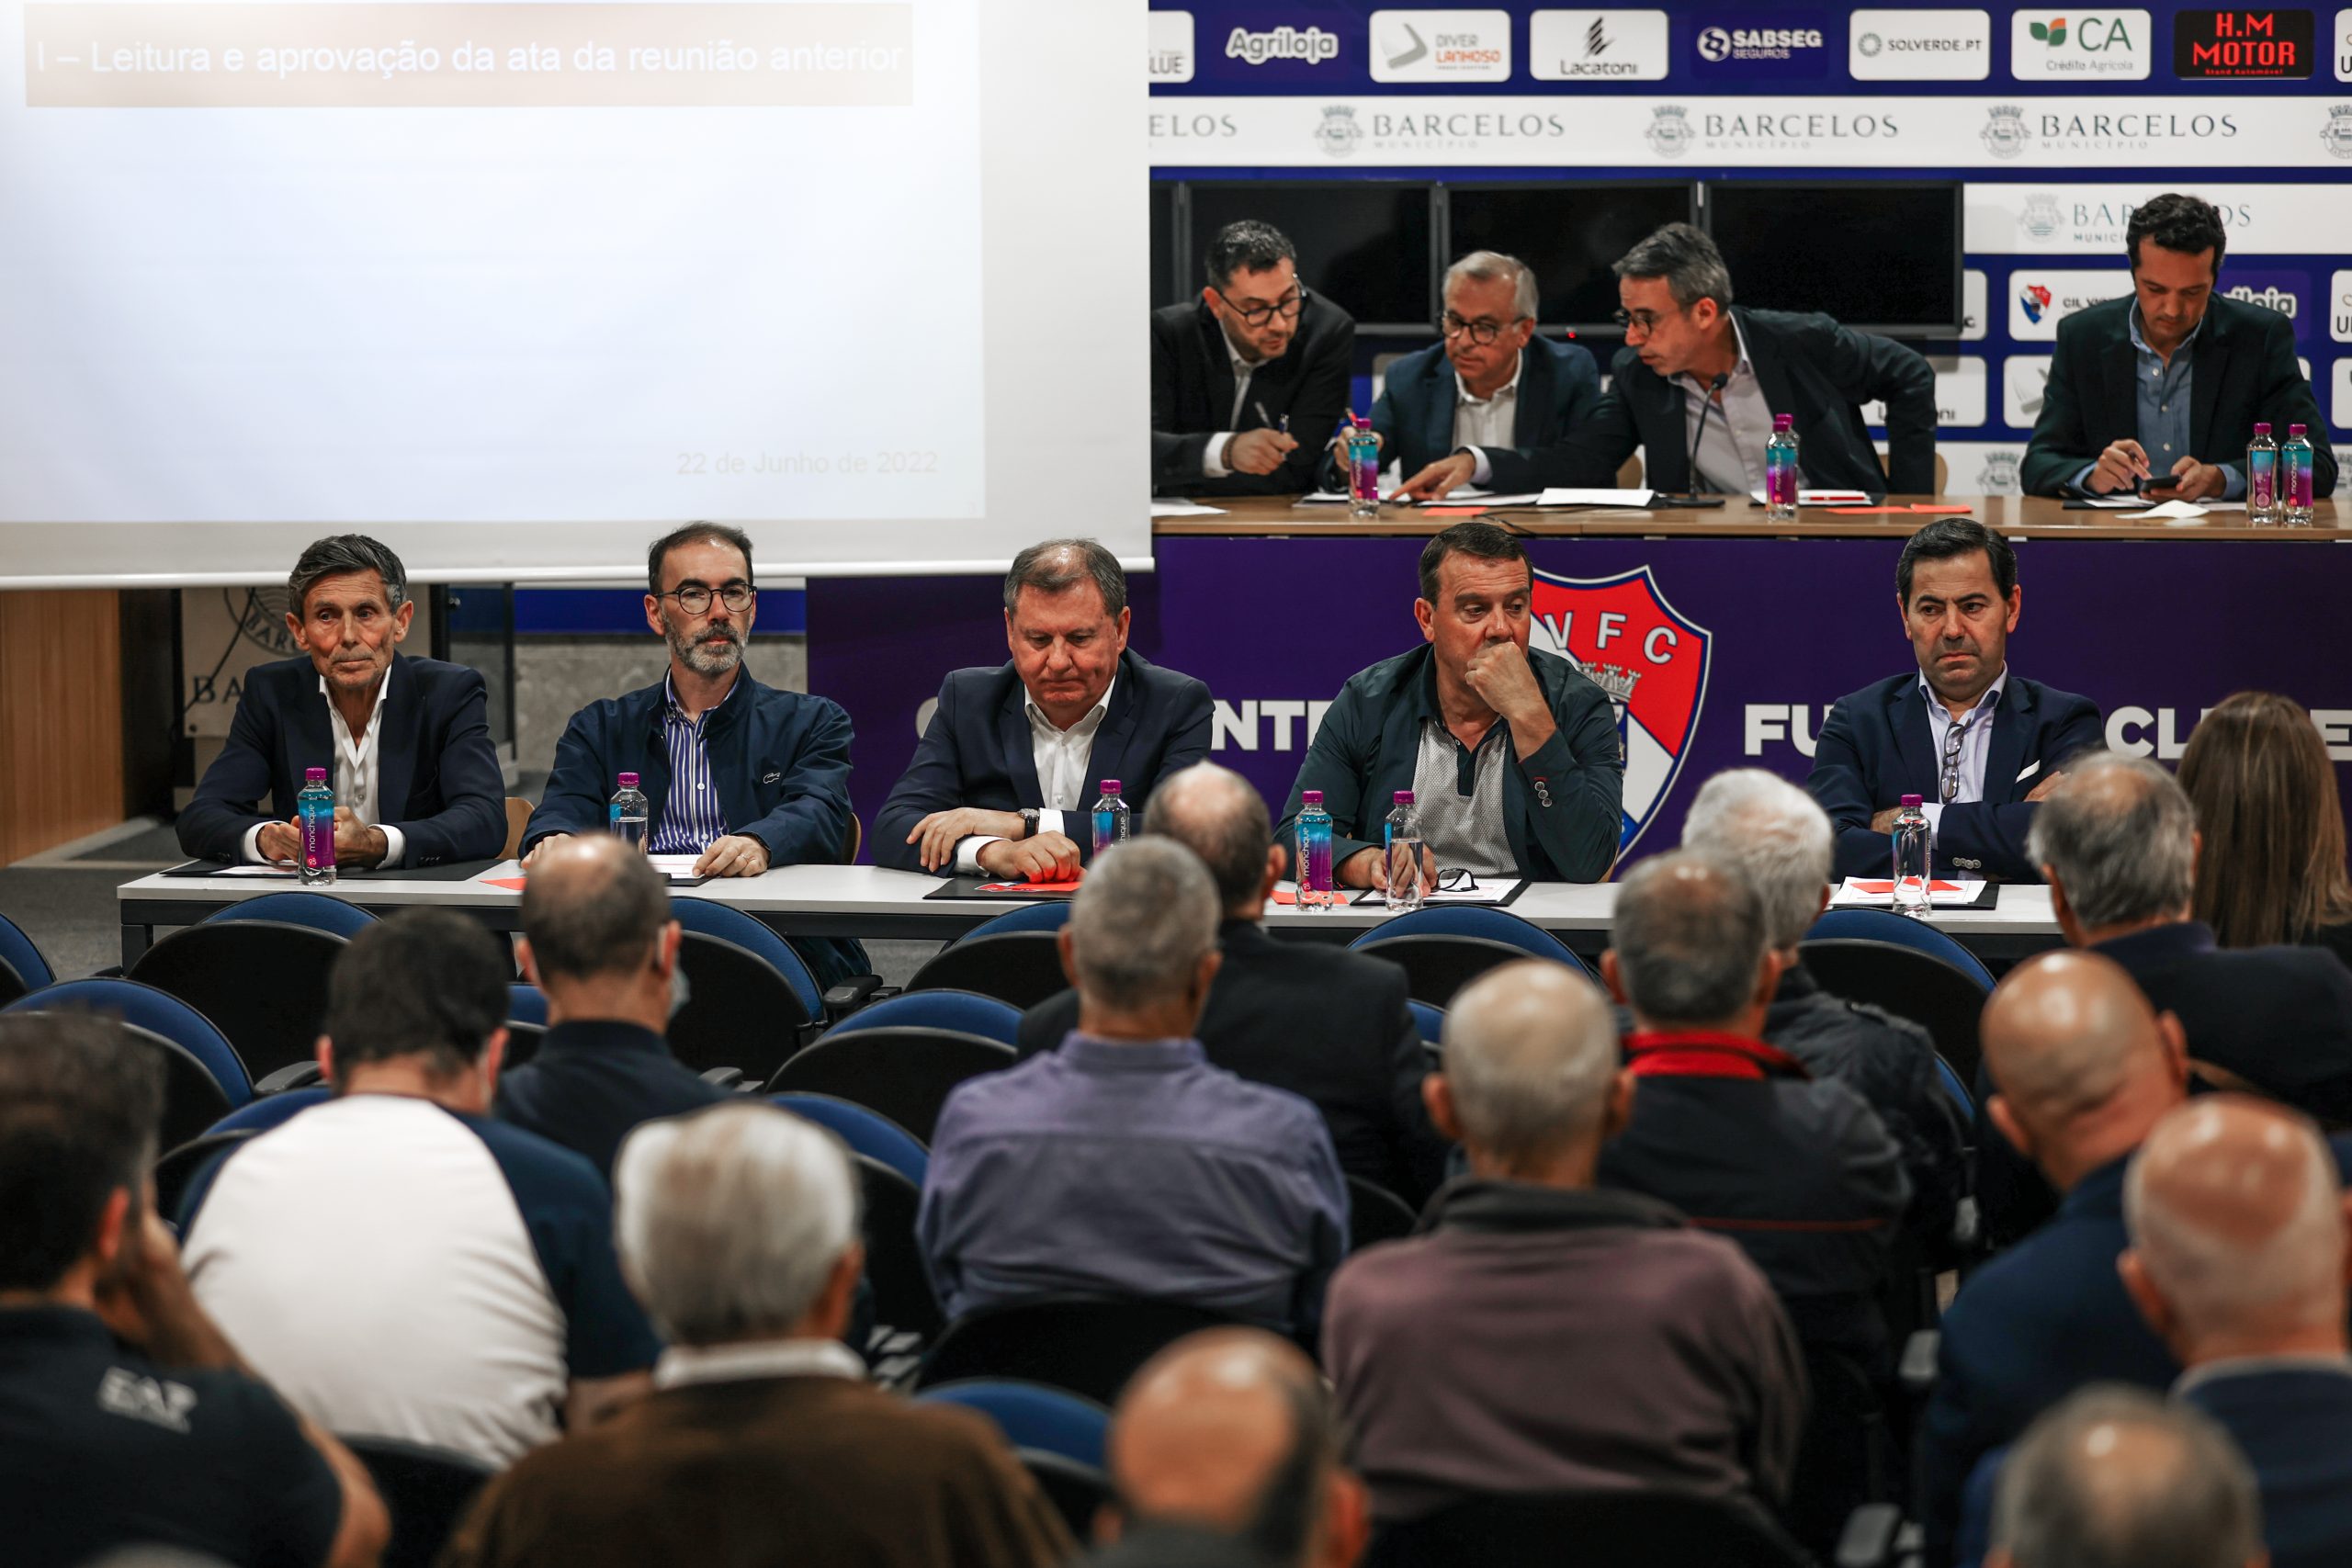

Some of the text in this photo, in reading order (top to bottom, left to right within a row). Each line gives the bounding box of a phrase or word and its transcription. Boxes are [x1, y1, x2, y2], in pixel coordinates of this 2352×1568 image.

[2078, 17, 2133, 51] CA
[2216, 12, 2274, 37] H.M
[1227, 28, 1338, 63] Agriloja
[1436, 34, 1478, 47] DIVER
[1733, 30, 1823, 48] SABSEG
[1888, 39, 1982, 51] SOLVERDE.PT
[92, 41, 211, 72] Leitura
[223, 48, 244, 72] e
[256, 40, 440, 79] aprovação
[452, 41, 495, 72] da
[507, 42, 561, 72] ata
[573, 41, 616, 72] da
[628, 40, 758, 72] reunião
[770, 41, 905, 72] anterior
[1733, 49, 1791, 59] SEGUROS
[2193, 41, 2295, 66] MOTOR
[1148, 56, 1184, 74] LUE
[1561, 60, 1639, 75] Lacatoni
[2046, 60, 2086, 71] Crédito
[1148, 115, 1238, 137] ELOS
[1374, 114, 1566, 137] BARCELOS
[1705, 114, 1899, 138] BARCELOS
[2041, 115, 2237, 137] BARCELOS
[676, 450, 939, 475] 22 de Junho de 2022
[1302, 827, 1310, 876] monchique
